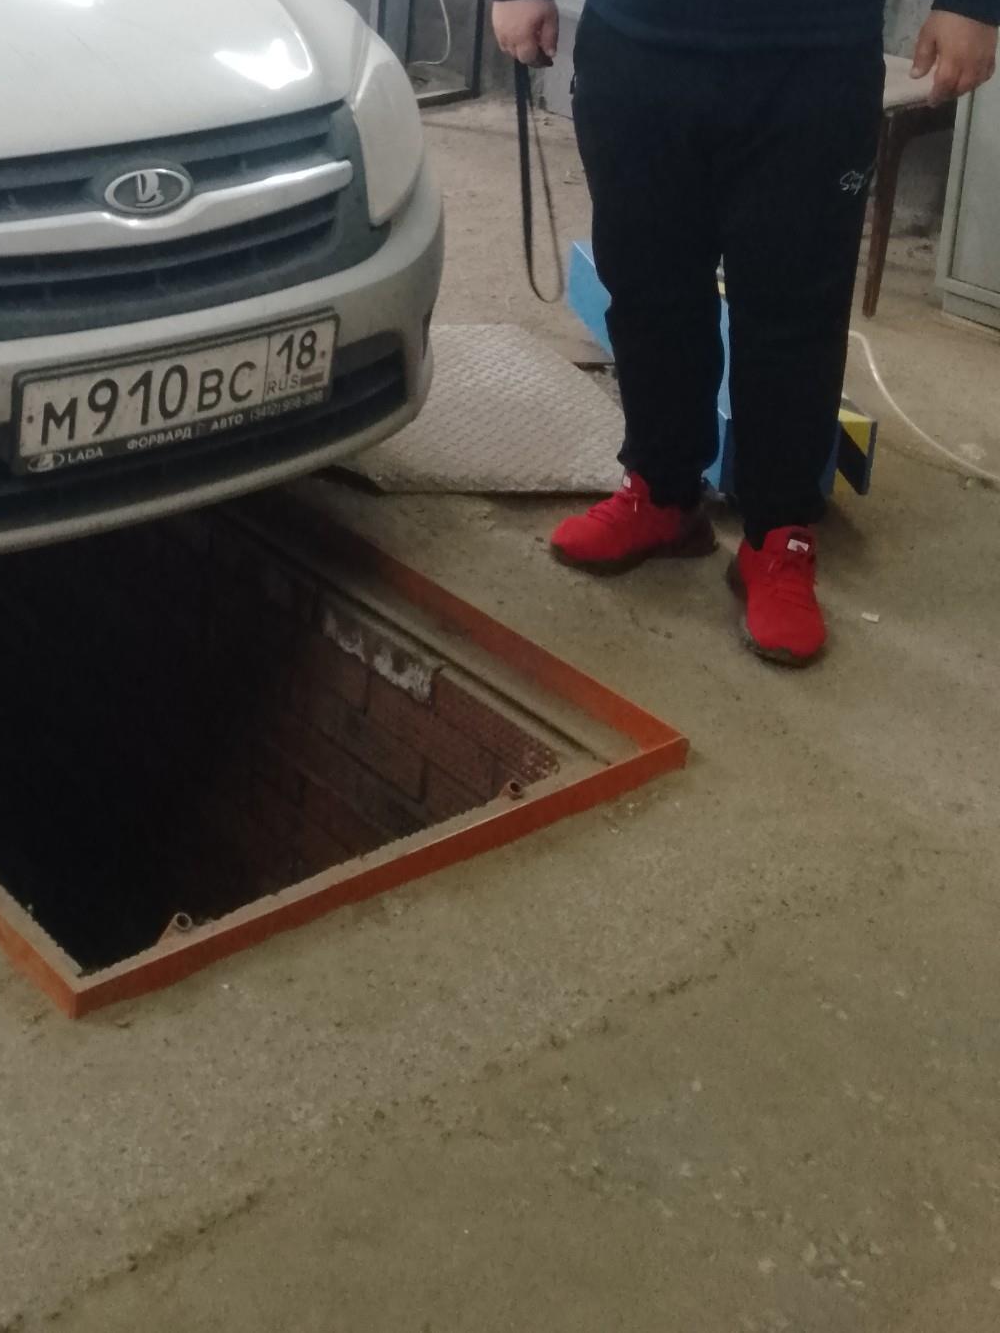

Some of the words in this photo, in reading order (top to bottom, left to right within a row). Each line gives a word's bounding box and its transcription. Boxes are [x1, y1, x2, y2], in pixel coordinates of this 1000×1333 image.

[40, 360, 257, 447] М910ВС
[276, 329, 318, 375] 18
[266, 372, 299, 396] RUS
[67, 446, 104, 464] LADA
[126, 426, 193, 451] ФОРВАРД
[210, 413, 244, 433] АВТО
